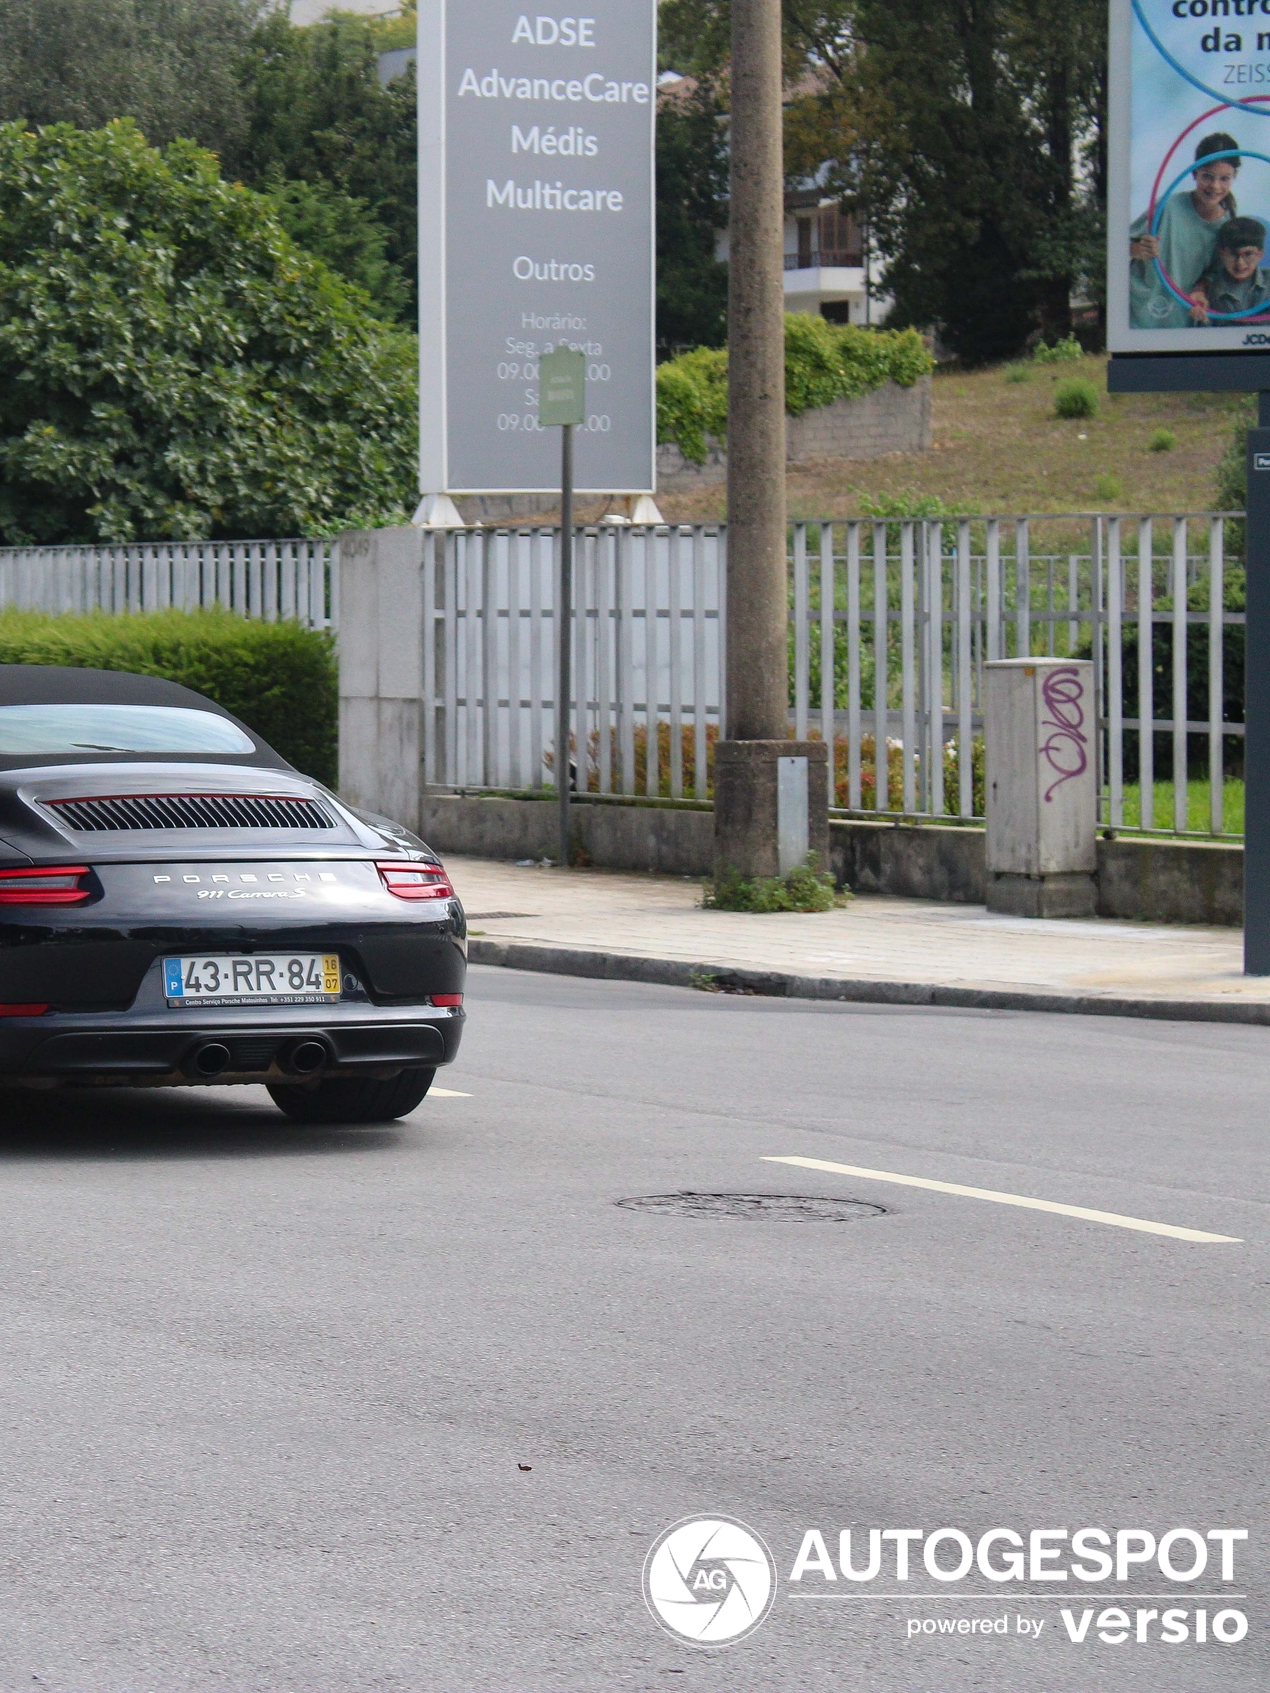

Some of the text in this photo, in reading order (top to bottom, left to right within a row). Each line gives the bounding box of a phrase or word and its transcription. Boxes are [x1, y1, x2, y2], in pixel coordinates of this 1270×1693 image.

[511, 15, 596, 47] ADSE
[1201, 26, 1242, 52] da
[457, 68, 650, 103] AdvanceCare
[511, 125, 598, 156] Médis
[486, 179, 623, 211] Multicare
[513, 256, 596, 282] Outros
[521, 311, 588, 330] Horário:
[505, 336, 539, 358] Seg.
[544, 342, 554, 354] a
[153, 872, 339, 884] PORSCHE
[197, 887, 307, 899] 911 Carrera S
[324, 959, 337, 970] 16
[170, 981, 179, 991] P
[325, 978, 338, 989] 07
